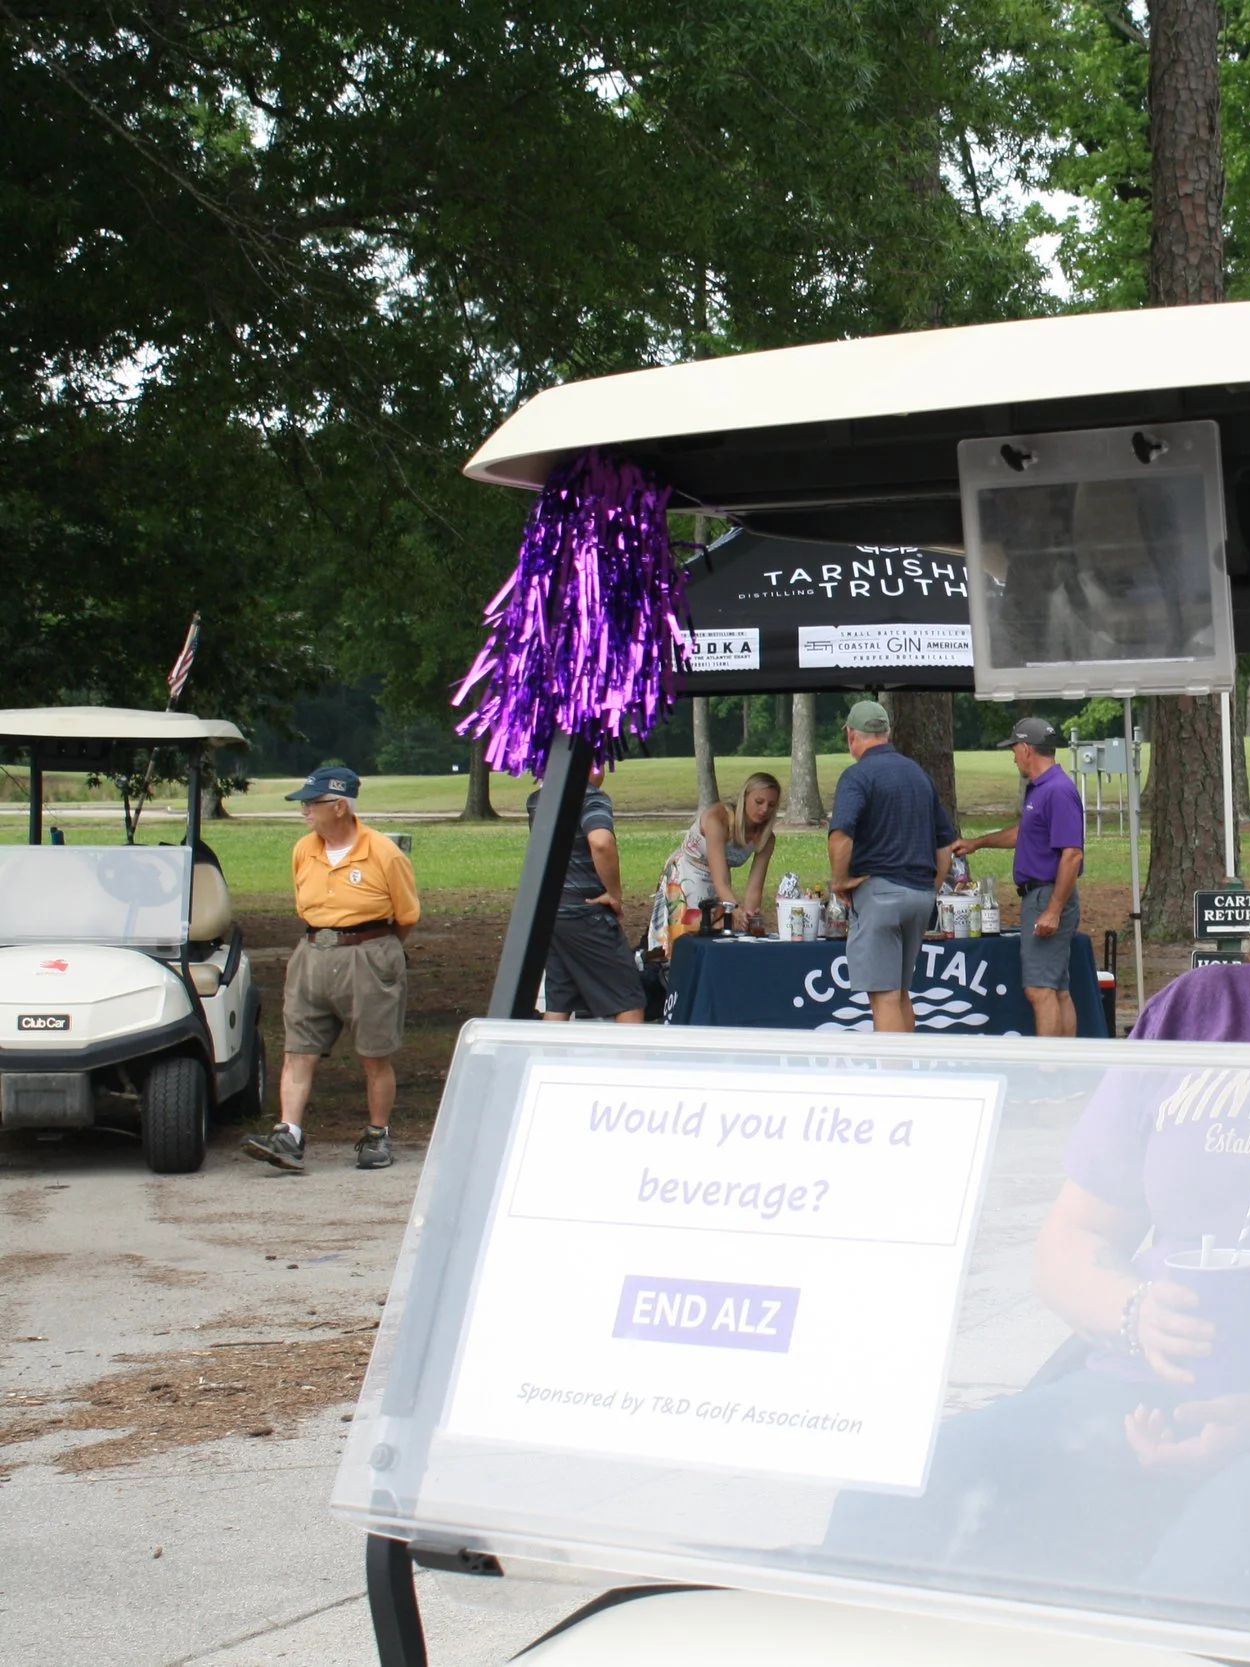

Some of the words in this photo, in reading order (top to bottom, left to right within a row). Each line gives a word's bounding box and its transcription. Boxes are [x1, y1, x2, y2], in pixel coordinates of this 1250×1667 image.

[738, 589, 815, 600] DISTILLING
[818, 578, 968, 598] TRUTH
[692, 641, 752, 655] ODKA
[838, 642, 881, 651] COASTAL
[886, 637, 922, 653] GIN
[926, 641, 969, 650] AMERICAN
[804, 944, 988, 1003] COTAL
[22, 1017, 46, 1028] Club
[47, 1017, 66, 1028] Car
[589, 1100, 707, 1138] Would
[716, 1110, 787, 1147] you
[802, 1106, 875, 1145] like
[888, 1118, 914, 1146] a
[637, 1167, 830, 1220] beverage?
[632, 1290, 707, 1328] END
[711, 1298, 782, 1335] ALZ
[516, 1382, 617, 1410] Sponsored
[620, 1391, 646, 1415] by
[652, 1396, 691, 1416] T&D
[695, 1401, 741, 1424] Golf
[742, 1404, 863, 1435] Association
